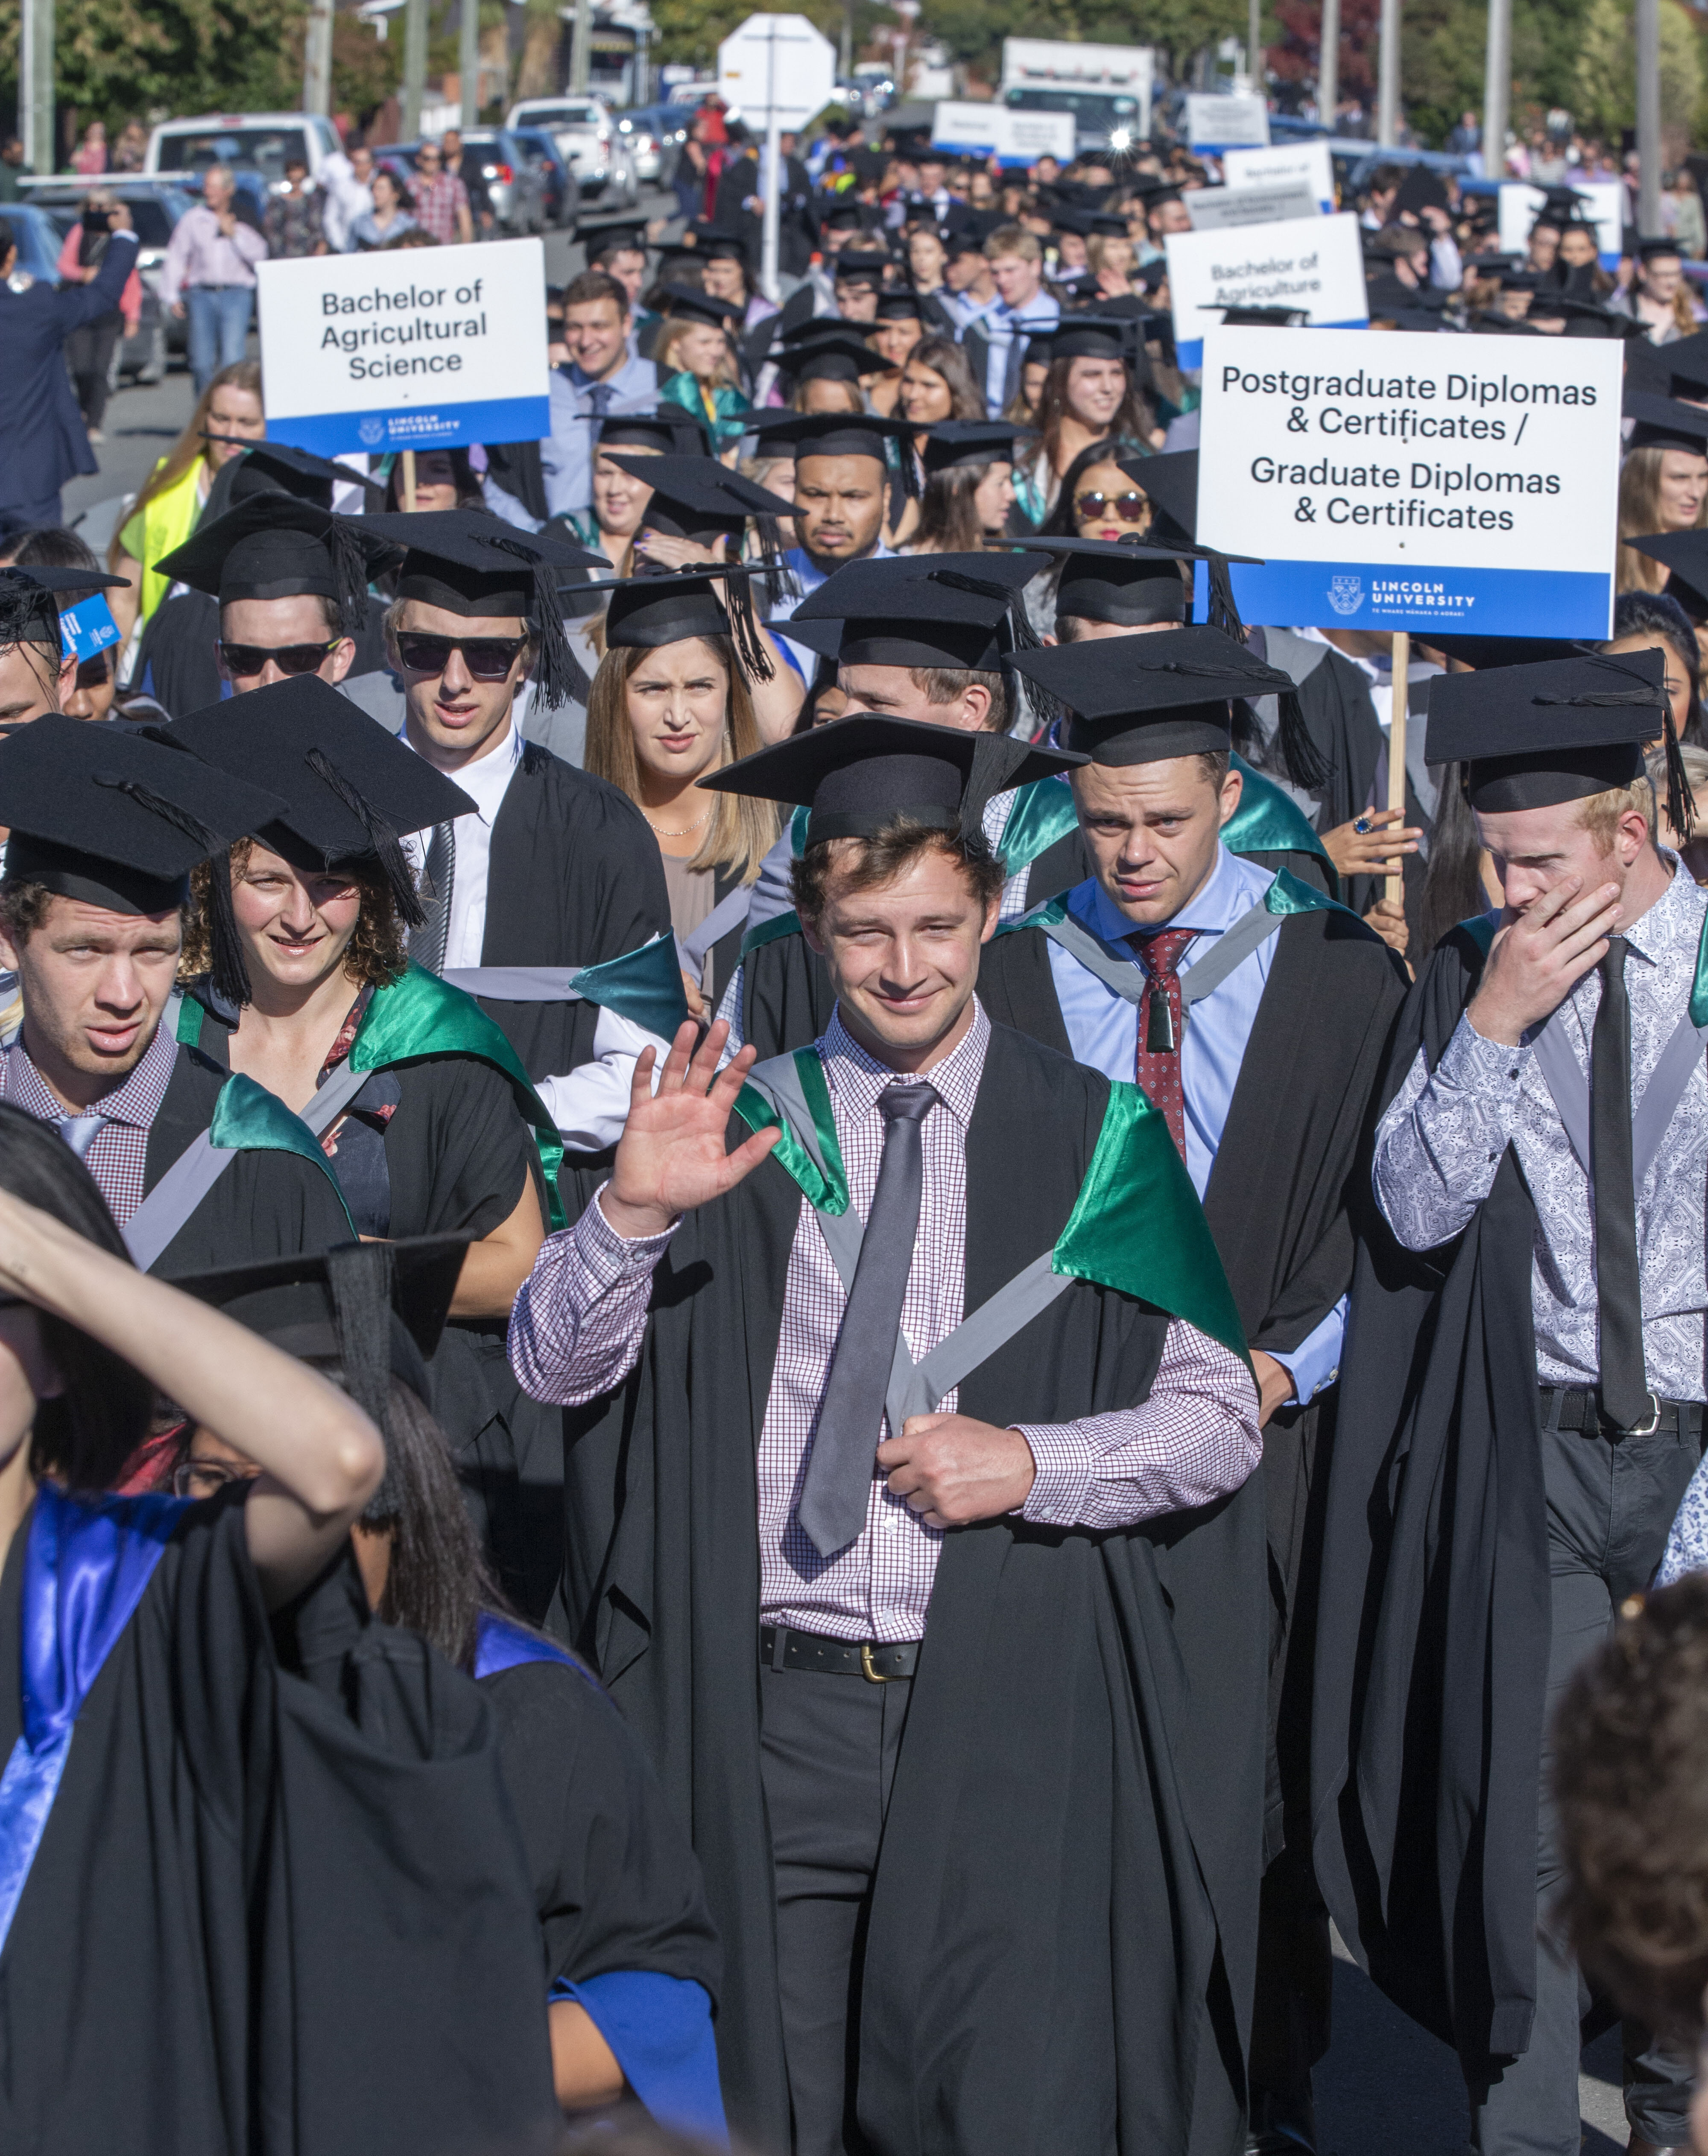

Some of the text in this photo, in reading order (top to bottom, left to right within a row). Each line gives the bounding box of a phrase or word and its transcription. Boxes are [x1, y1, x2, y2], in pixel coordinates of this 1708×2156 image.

[1211, 252, 1318, 281] Bachelor of
[322, 278, 482, 316] Bachelor of
[1215, 279, 1321, 304] Agriculture
[320, 312, 487, 353] Agricultural
[349, 354, 462, 380] Science
[1222, 366, 1597, 408] Postgraduate Diplomas
[388, 415, 438, 426] LINCOLN
[389, 421, 460, 435] UNIVERSITY
[1286, 406, 1529, 446] & Certificates /
[1250, 456, 1561, 497] Graduate Diplomas
[1294, 496, 1514, 531] & Certificates
[1372, 581, 1443, 593] LINCOLN
[1372, 593, 1475, 607] UNIVERSITY
